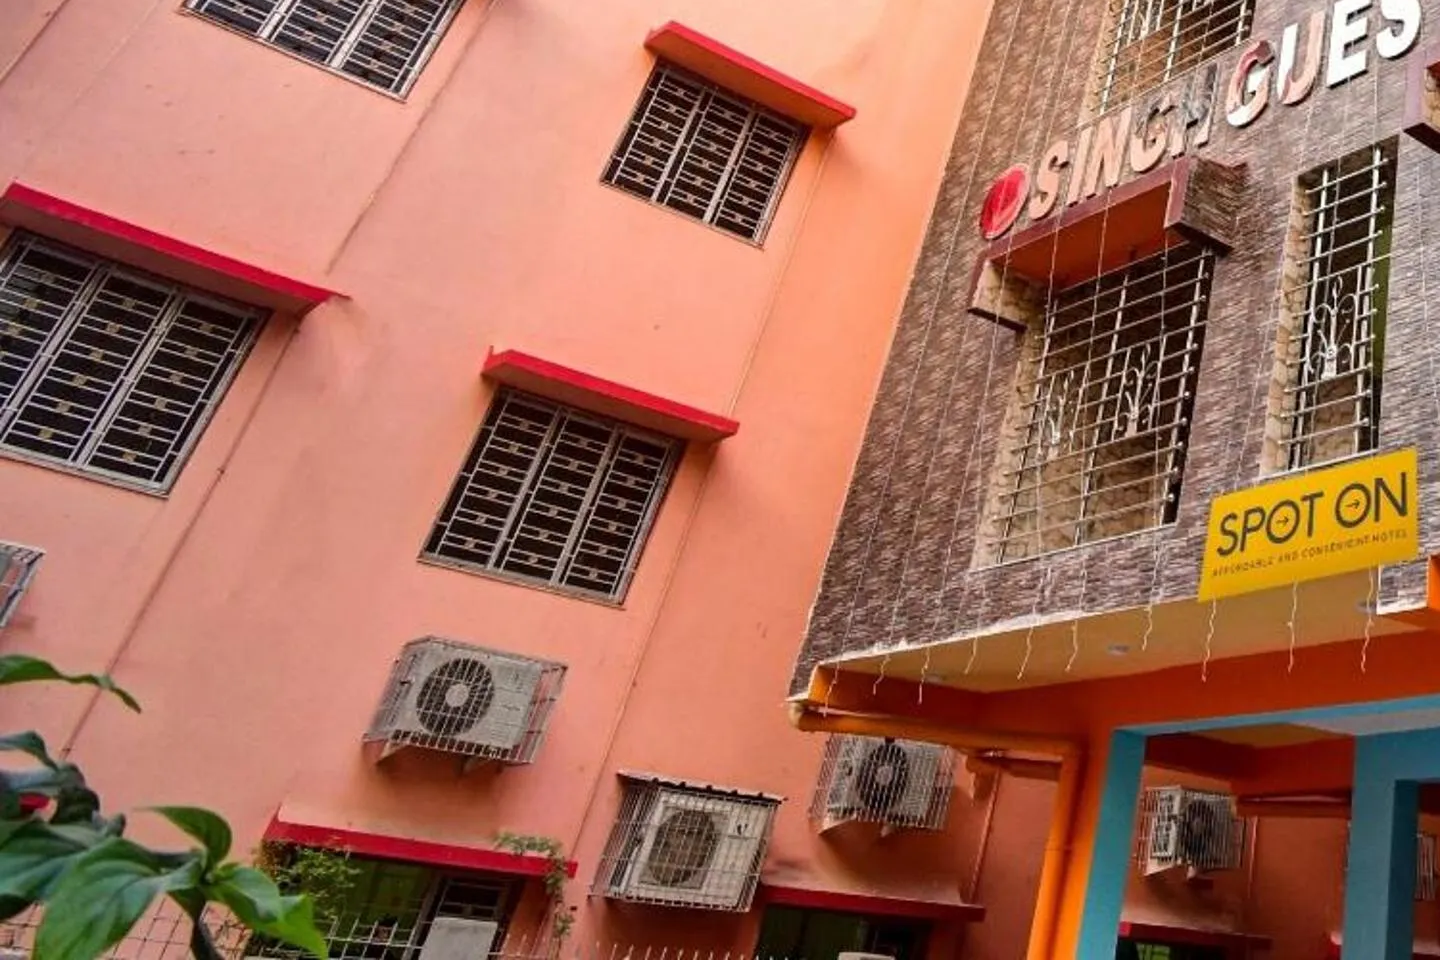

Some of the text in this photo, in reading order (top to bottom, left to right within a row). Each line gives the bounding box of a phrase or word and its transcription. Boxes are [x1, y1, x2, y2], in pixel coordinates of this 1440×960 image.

[1216, 471, 1409, 557] SPOT ON
[1277, 549, 1299, 562] AND
[1372, 528, 1408, 542] HOTEL
